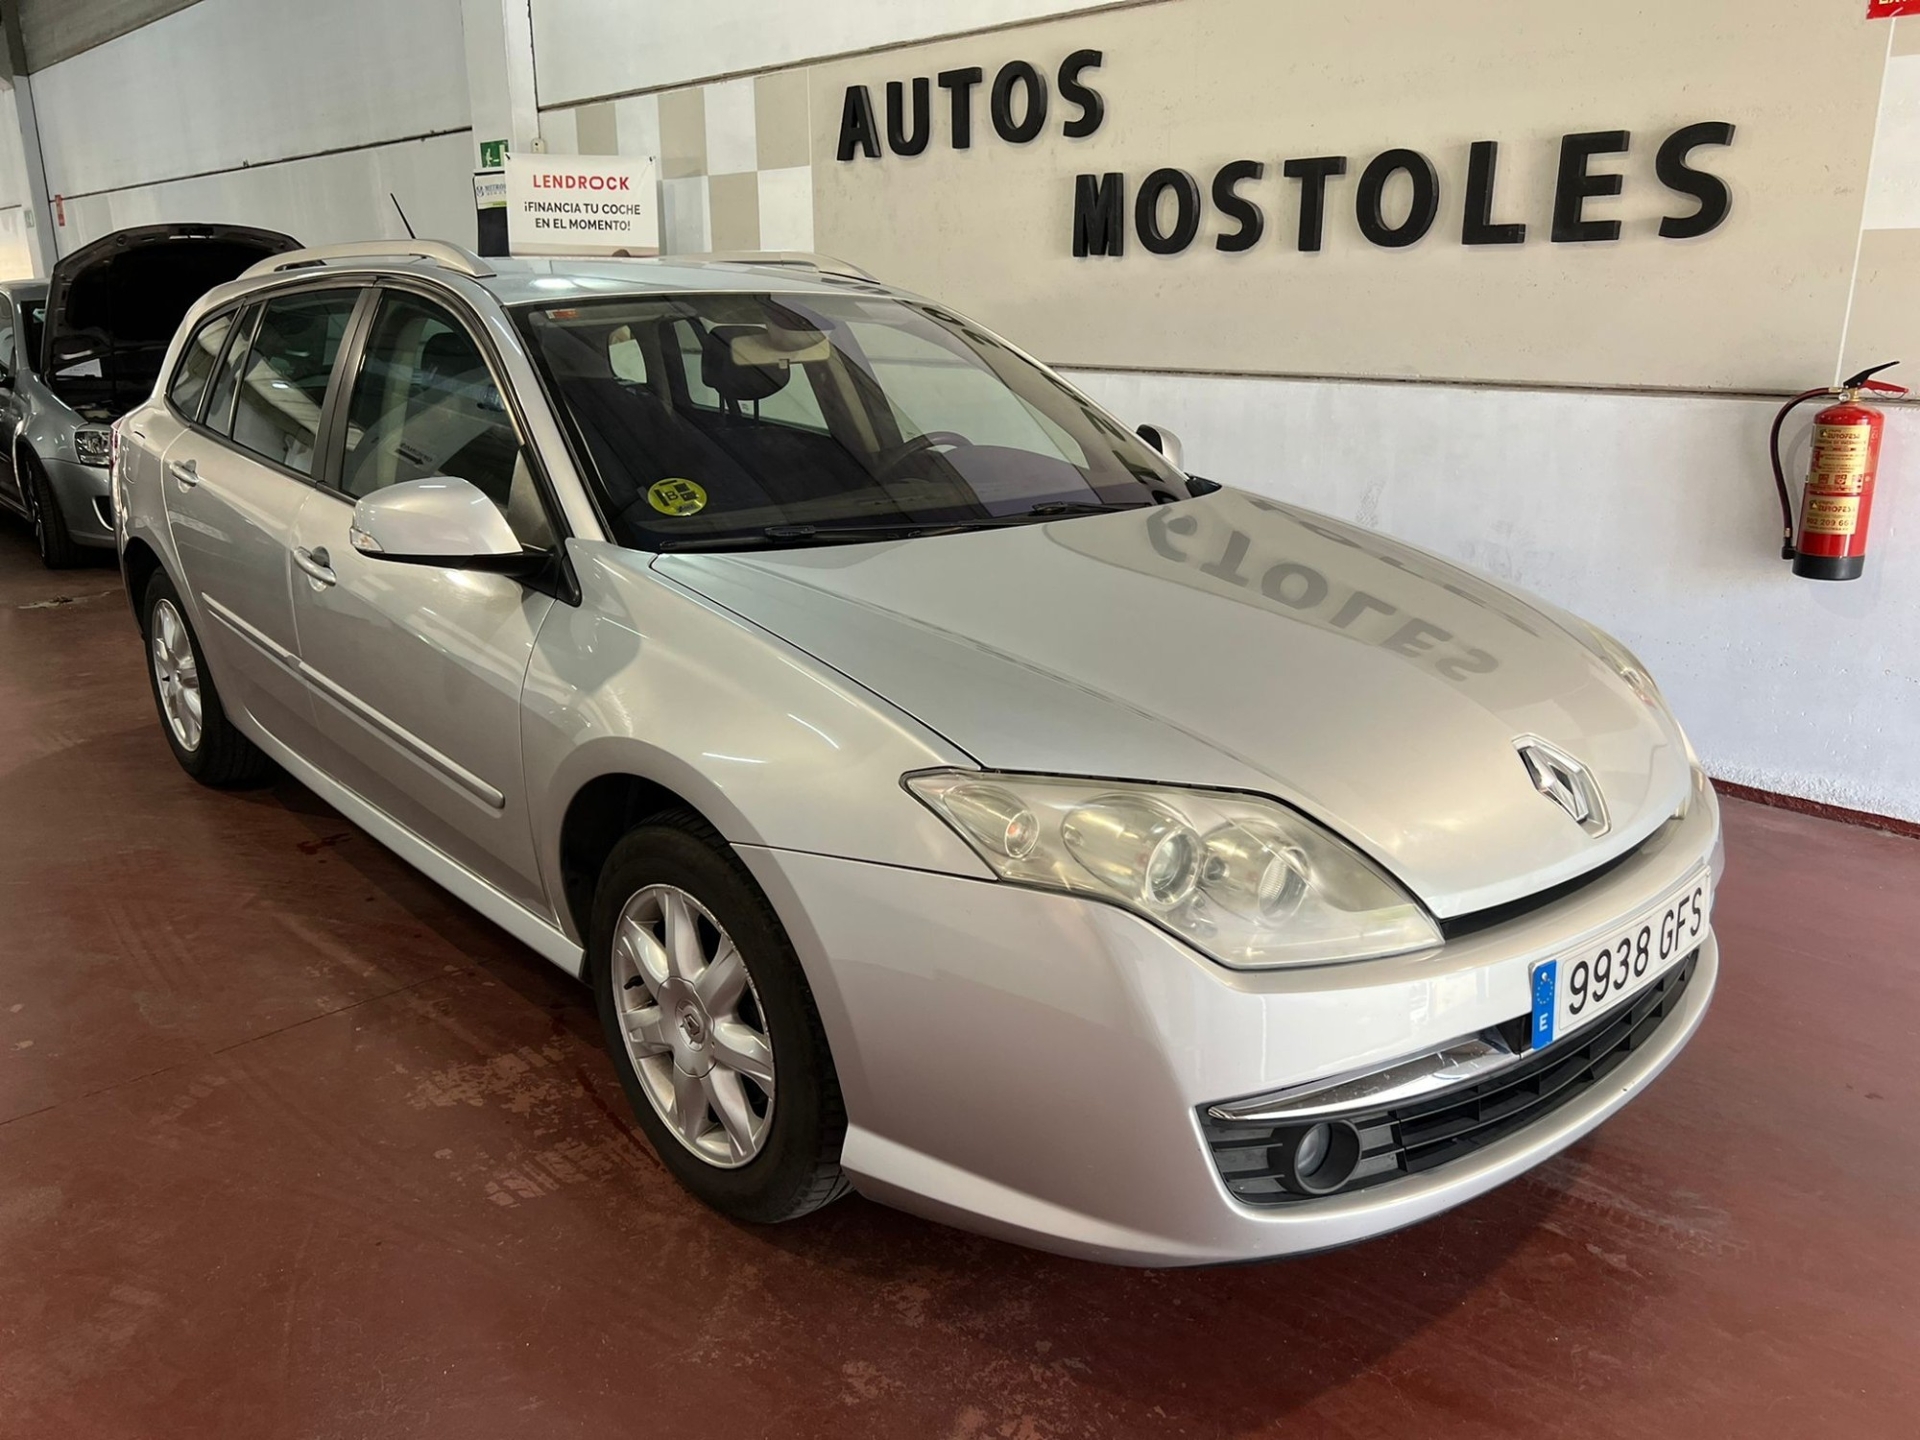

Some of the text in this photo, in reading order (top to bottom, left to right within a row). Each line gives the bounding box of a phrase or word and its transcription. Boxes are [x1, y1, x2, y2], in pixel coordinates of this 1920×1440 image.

[837, 49, 1104, 161] AUTOS
[533, 174, 630, 191] LENDROCK
[1072, 121, 1736, 258] MOSTOLES
[524, 201, 641, 215] ¡FINANCIA TU COCHE
[535, 218, 631, 231] EN EL MOMENTO!
[1568, 887, 1703, 1016] 9938 GFS
[1539, 1012, 1549, 1032] E
